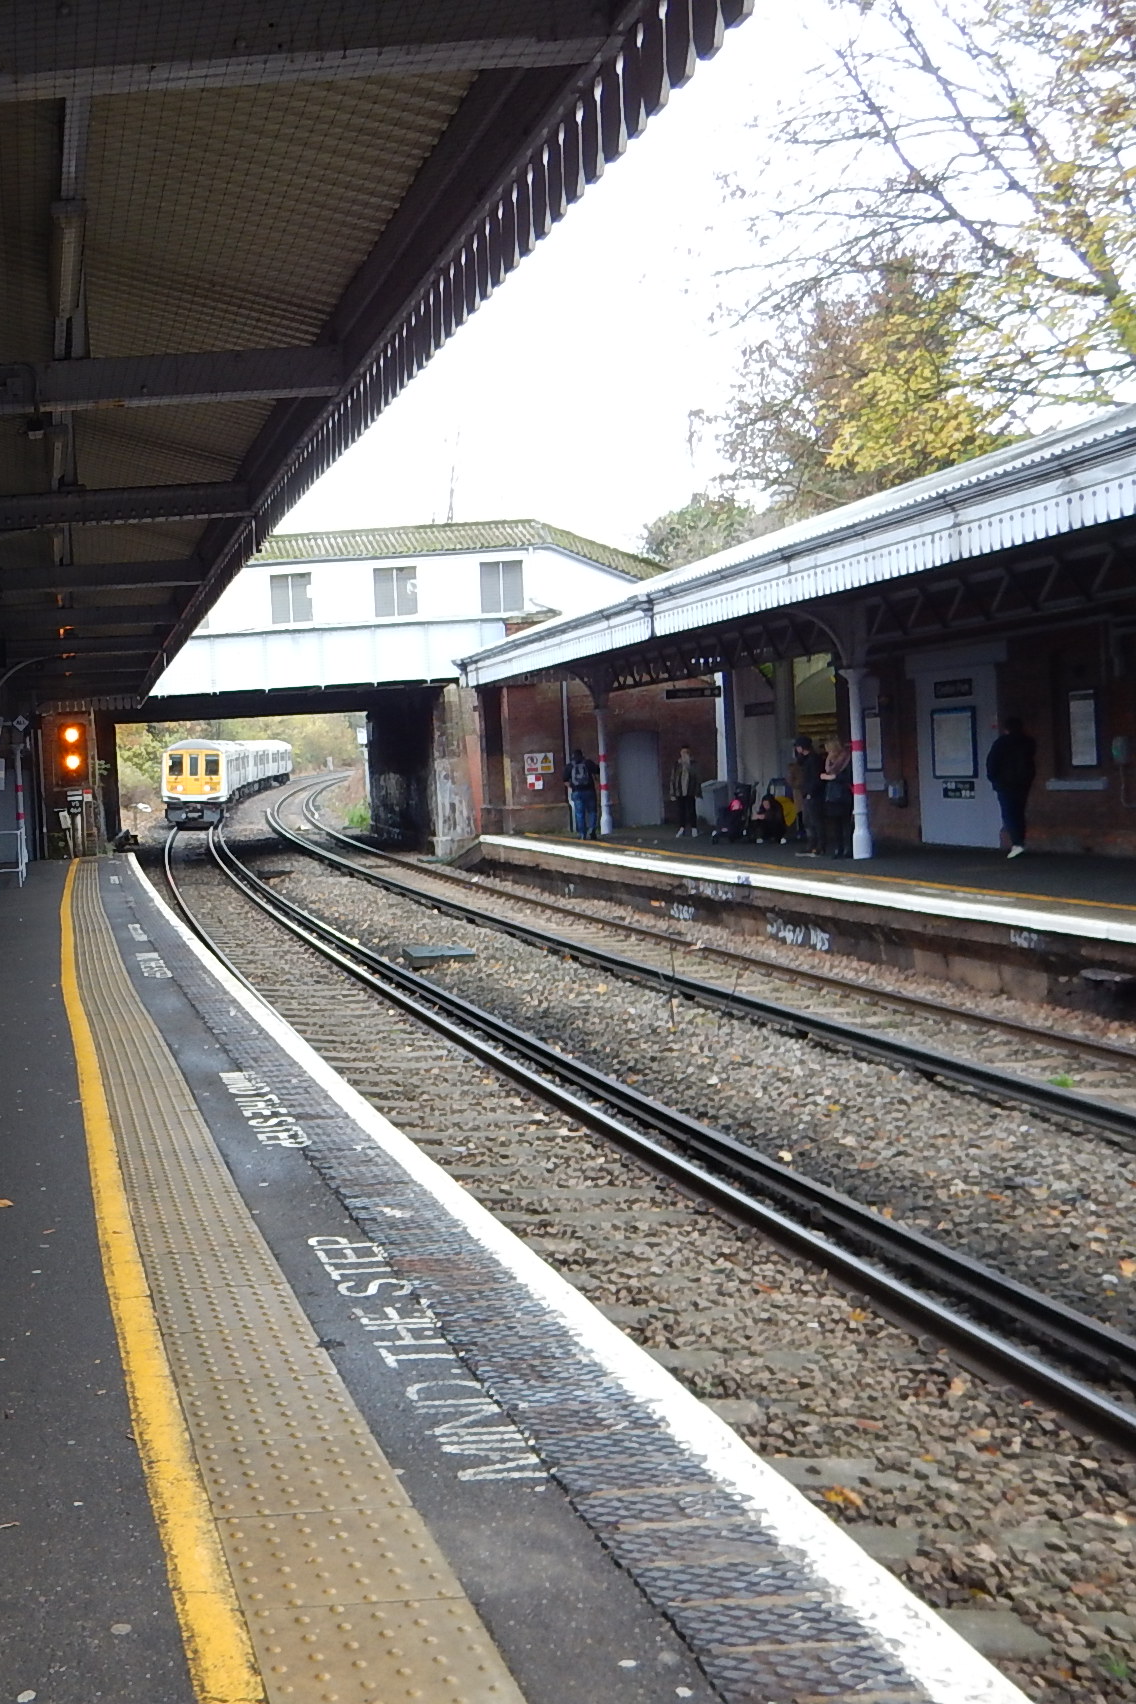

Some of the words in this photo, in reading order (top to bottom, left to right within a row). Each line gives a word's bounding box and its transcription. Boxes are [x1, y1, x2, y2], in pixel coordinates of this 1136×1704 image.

[234, 1093, 289, 1118] THE
[247, 1116, 313, 1148] STEP
[307, 1236, 414, 1297] STEP
[351, 1298, 465, 1369] THE
[405, 1378, 558, 1481] MIND
